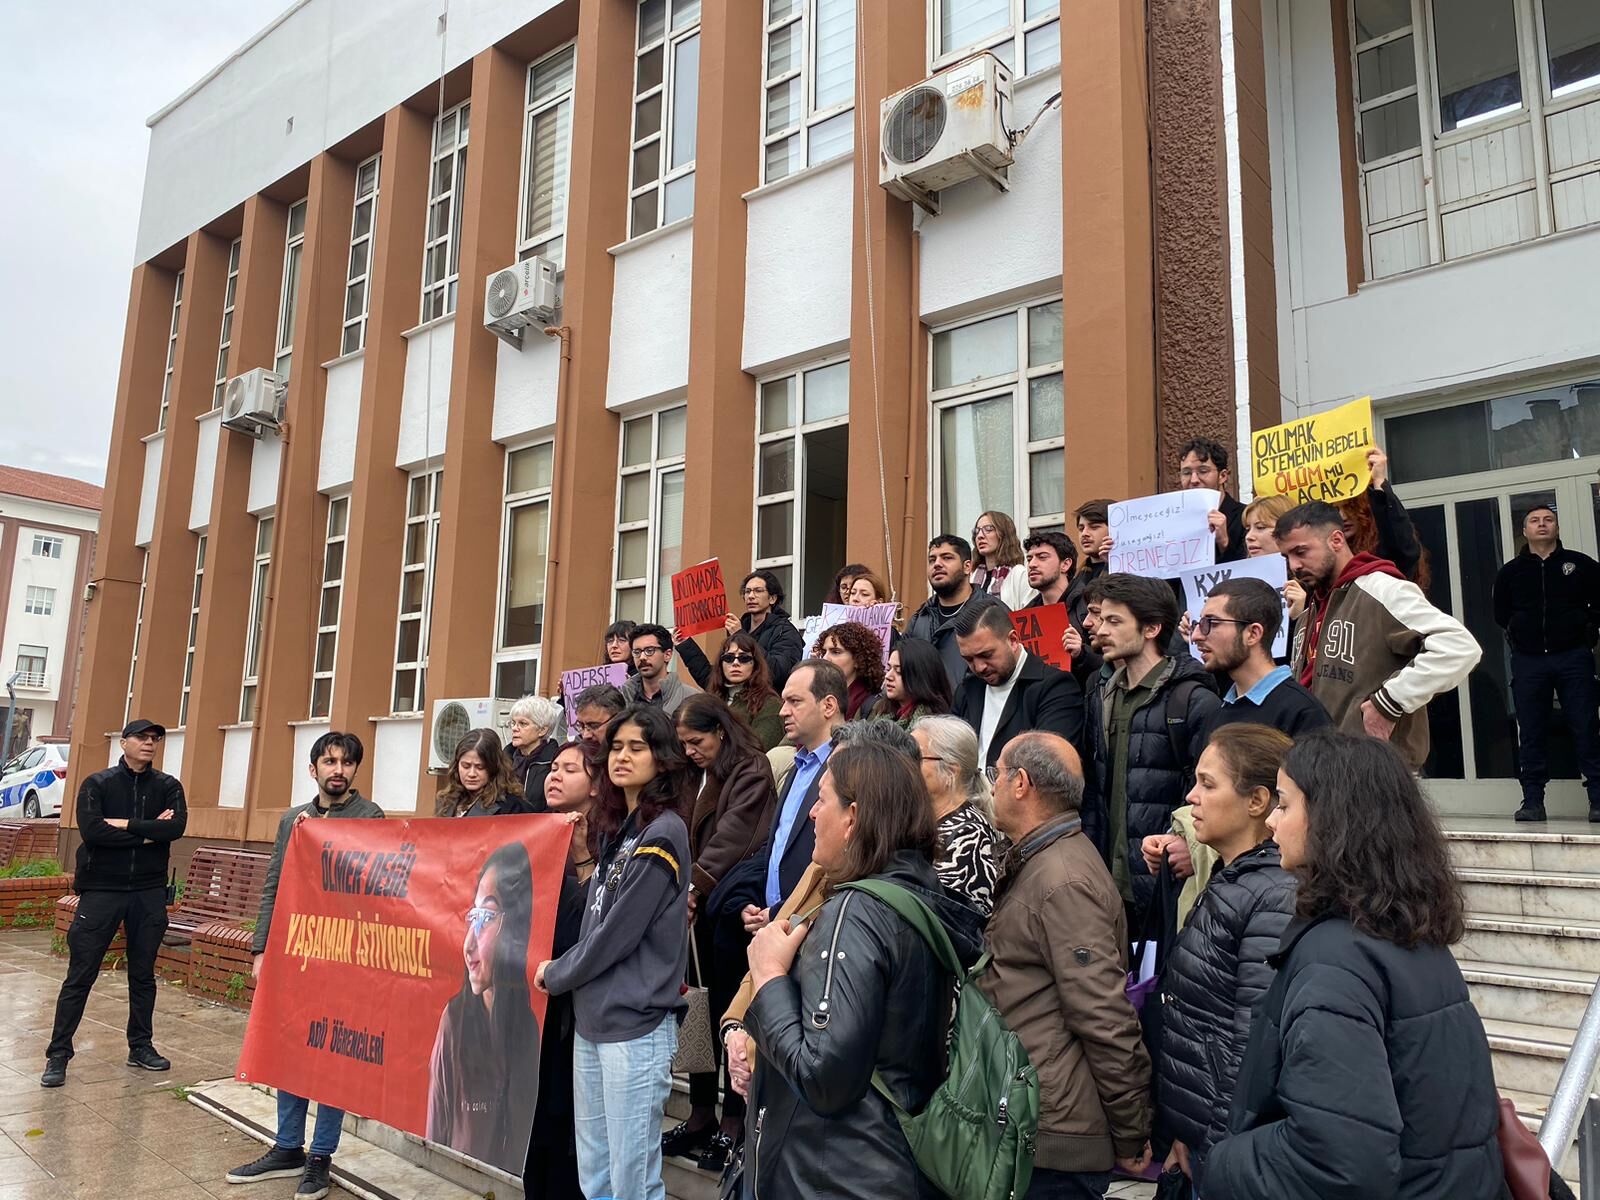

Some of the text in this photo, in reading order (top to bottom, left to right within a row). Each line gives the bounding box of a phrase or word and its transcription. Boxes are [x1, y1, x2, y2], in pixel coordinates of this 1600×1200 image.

[1255, 420, 1316, 459] OKUMAK
[1326, 427, 1369, 458] BEDELİ
[1275, 461, 1345, 494] ÖLÜM MÜ
[1324, 619, 1355, 665] 91
[1317, 664, 1354, 684] JEANS
[321, 841, 372, 895] ÖLMEK
[284, 911, 433, 978] YAŞAMAK İSTİYORUZ!
[307, 1017, 385, 1066] ADÜ ÖĞRENCİLERİ
